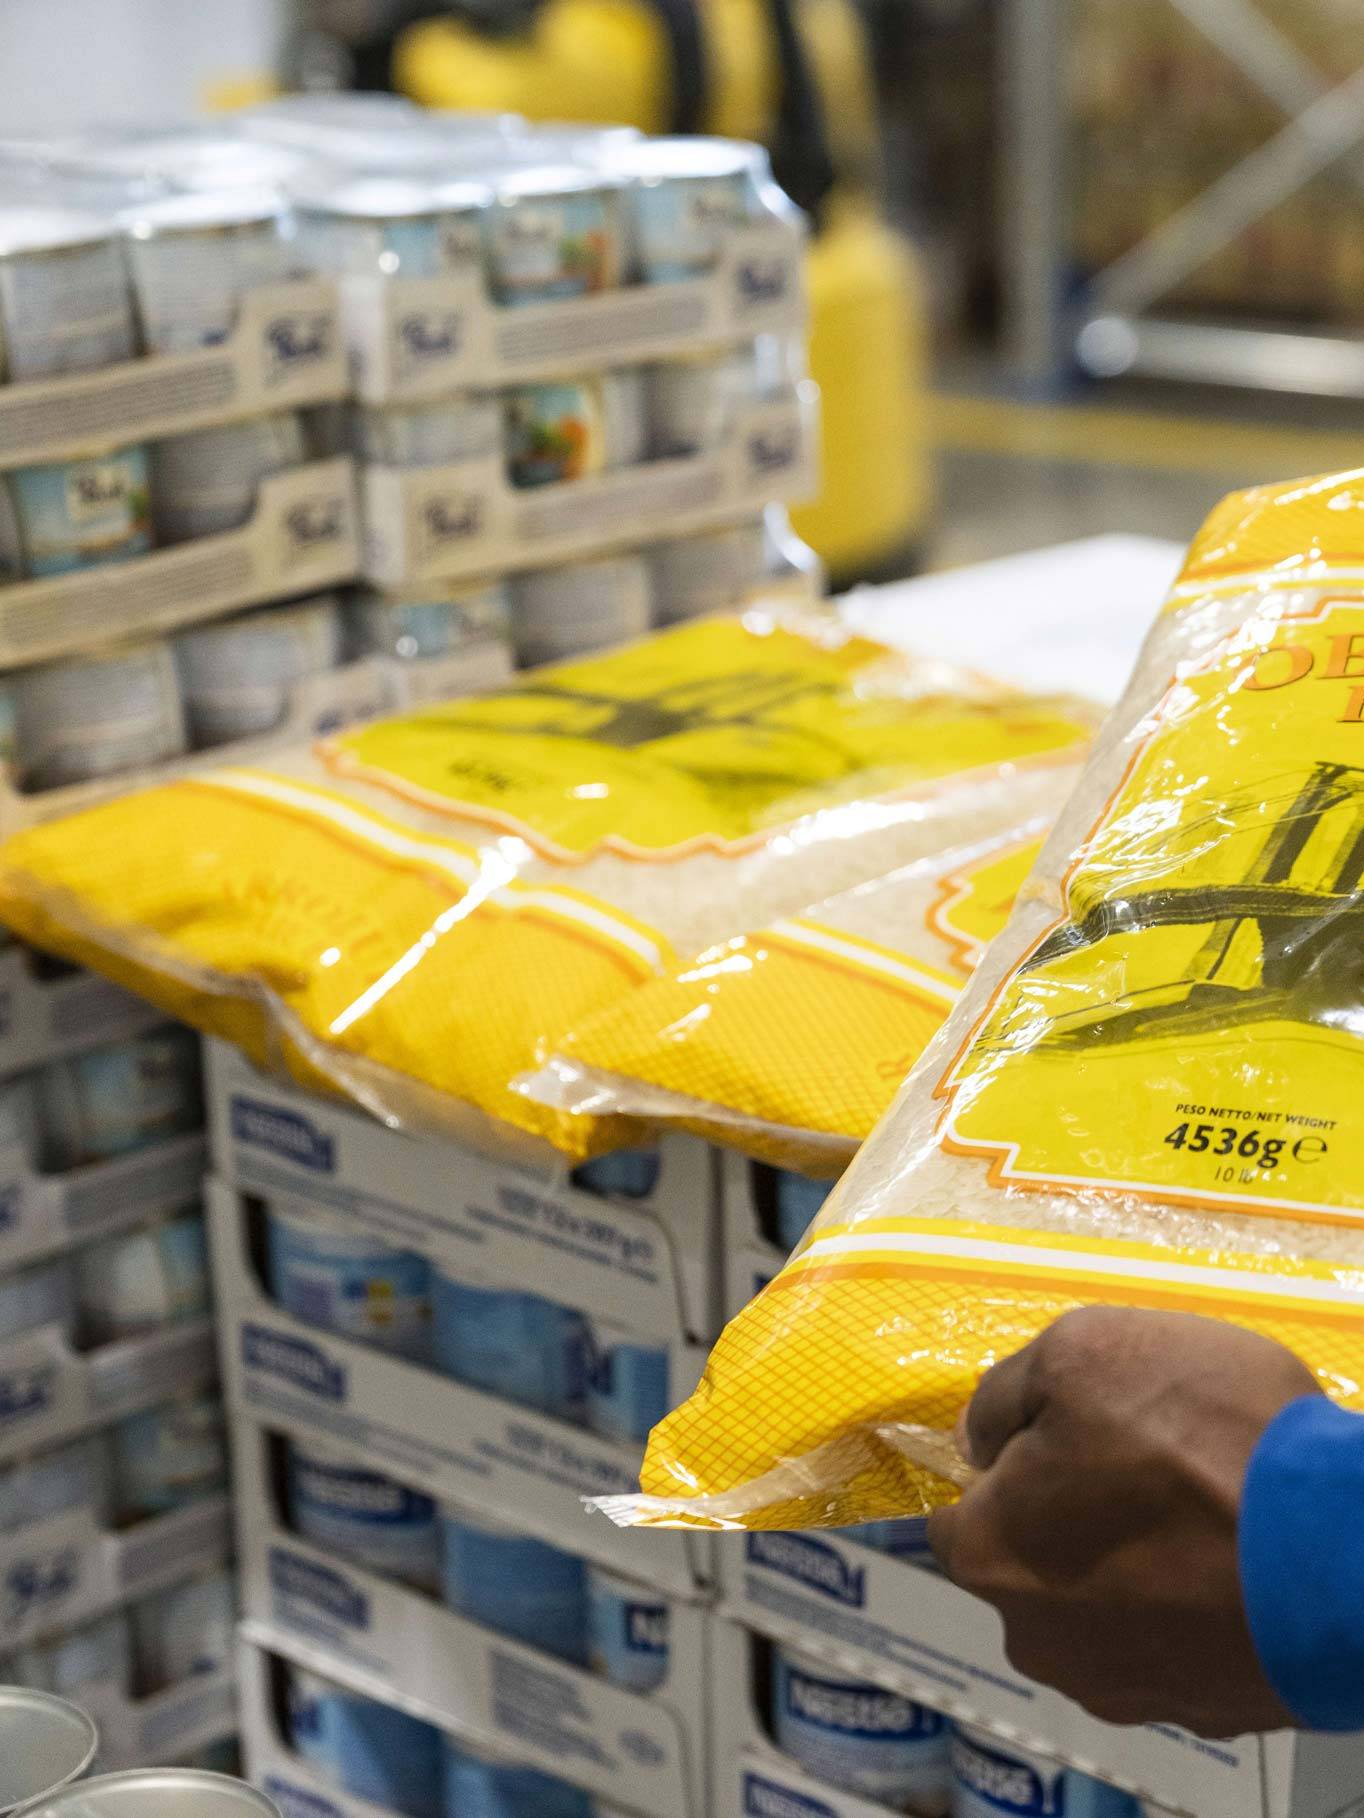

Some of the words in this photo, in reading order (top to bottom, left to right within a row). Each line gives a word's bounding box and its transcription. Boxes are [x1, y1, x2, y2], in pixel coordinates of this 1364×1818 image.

[1175, 1103, 1206, 1116] PESO
[1208, 1107, 1282, 1122] NETTO/NET
[1285, 1113, 1337, 1131] WEIGHT
[1163, 1122, 1287, 1169] 4536g
[1214, 1166, 1235, 1183] 10
